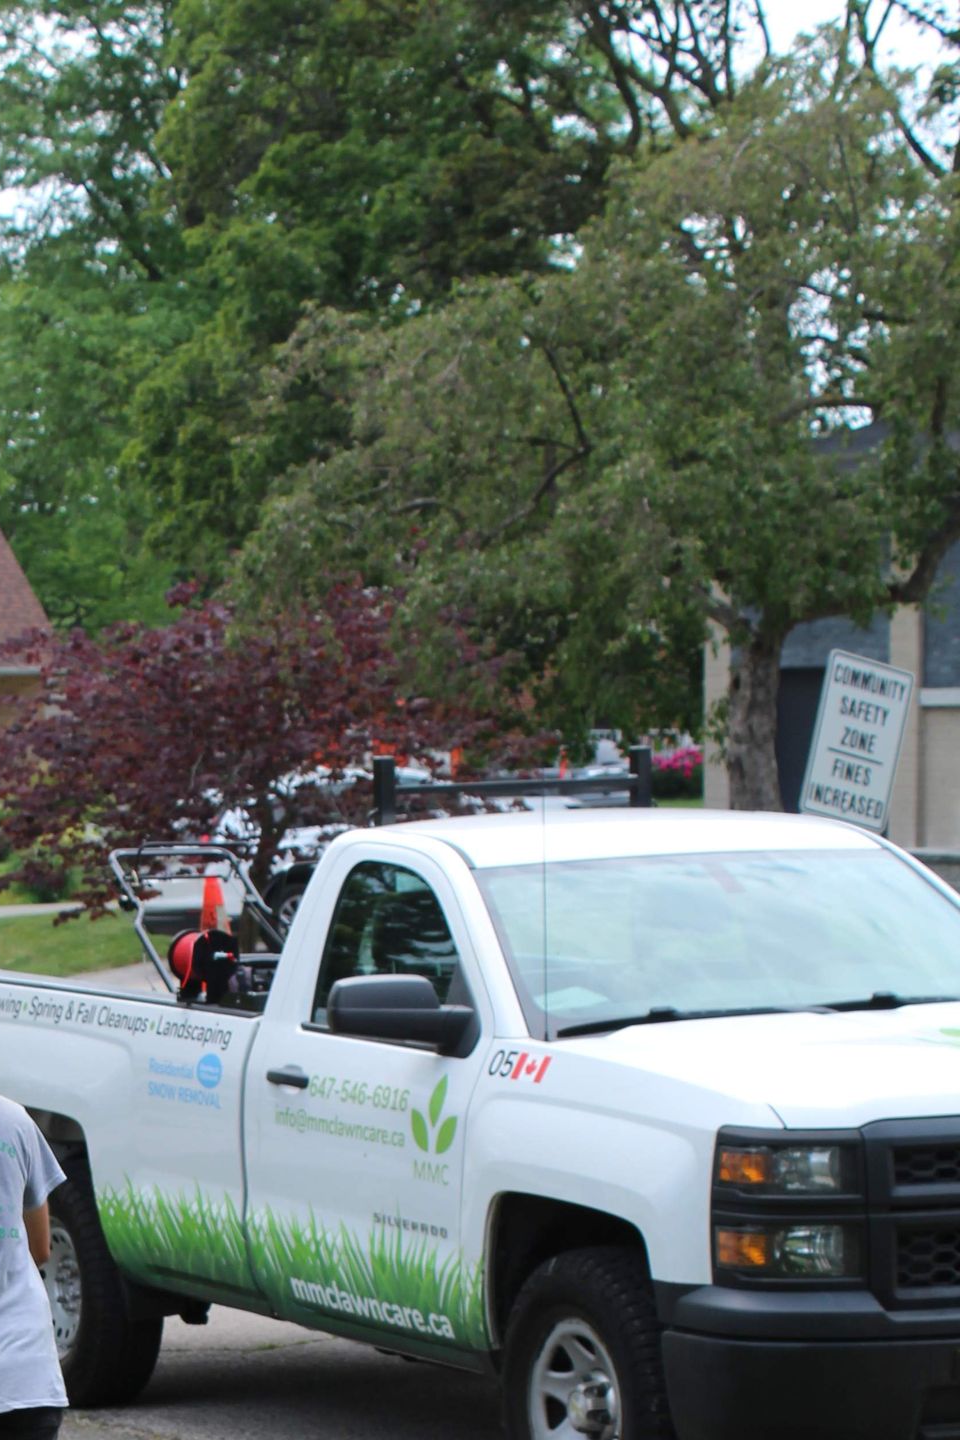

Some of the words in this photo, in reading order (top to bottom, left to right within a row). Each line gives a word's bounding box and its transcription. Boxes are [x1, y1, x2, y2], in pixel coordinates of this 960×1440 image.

[834, 663, 907, 700] COMMUNITY
[839, 696, 890, 727] SAFETY
[841, 726, 877, 753] ZONE
[832, 758, 872, 787] FINES
[807, 782, 885, 820] INCREASED
[28, 995, 62, 1024] Spring
[64, 1000, 75, 1021] &
[76, 1001, 97, 1024] Fall
[97, 1006, 149, 1036] Cleanups
[156, 1015, 233, 1050] Landscaping
[489, 1050, 518, 1077] 05
[309, 1075, 410, 1112] 647-546-6916
[275, 1105, 406, 1148] info@mmclawncare.ca
[412, 1160, 450, 1187] MMC
[373, 1211, 449, 1240] SILVERADO
[291, 1276, 456, 1340] mmclawncare.ca
